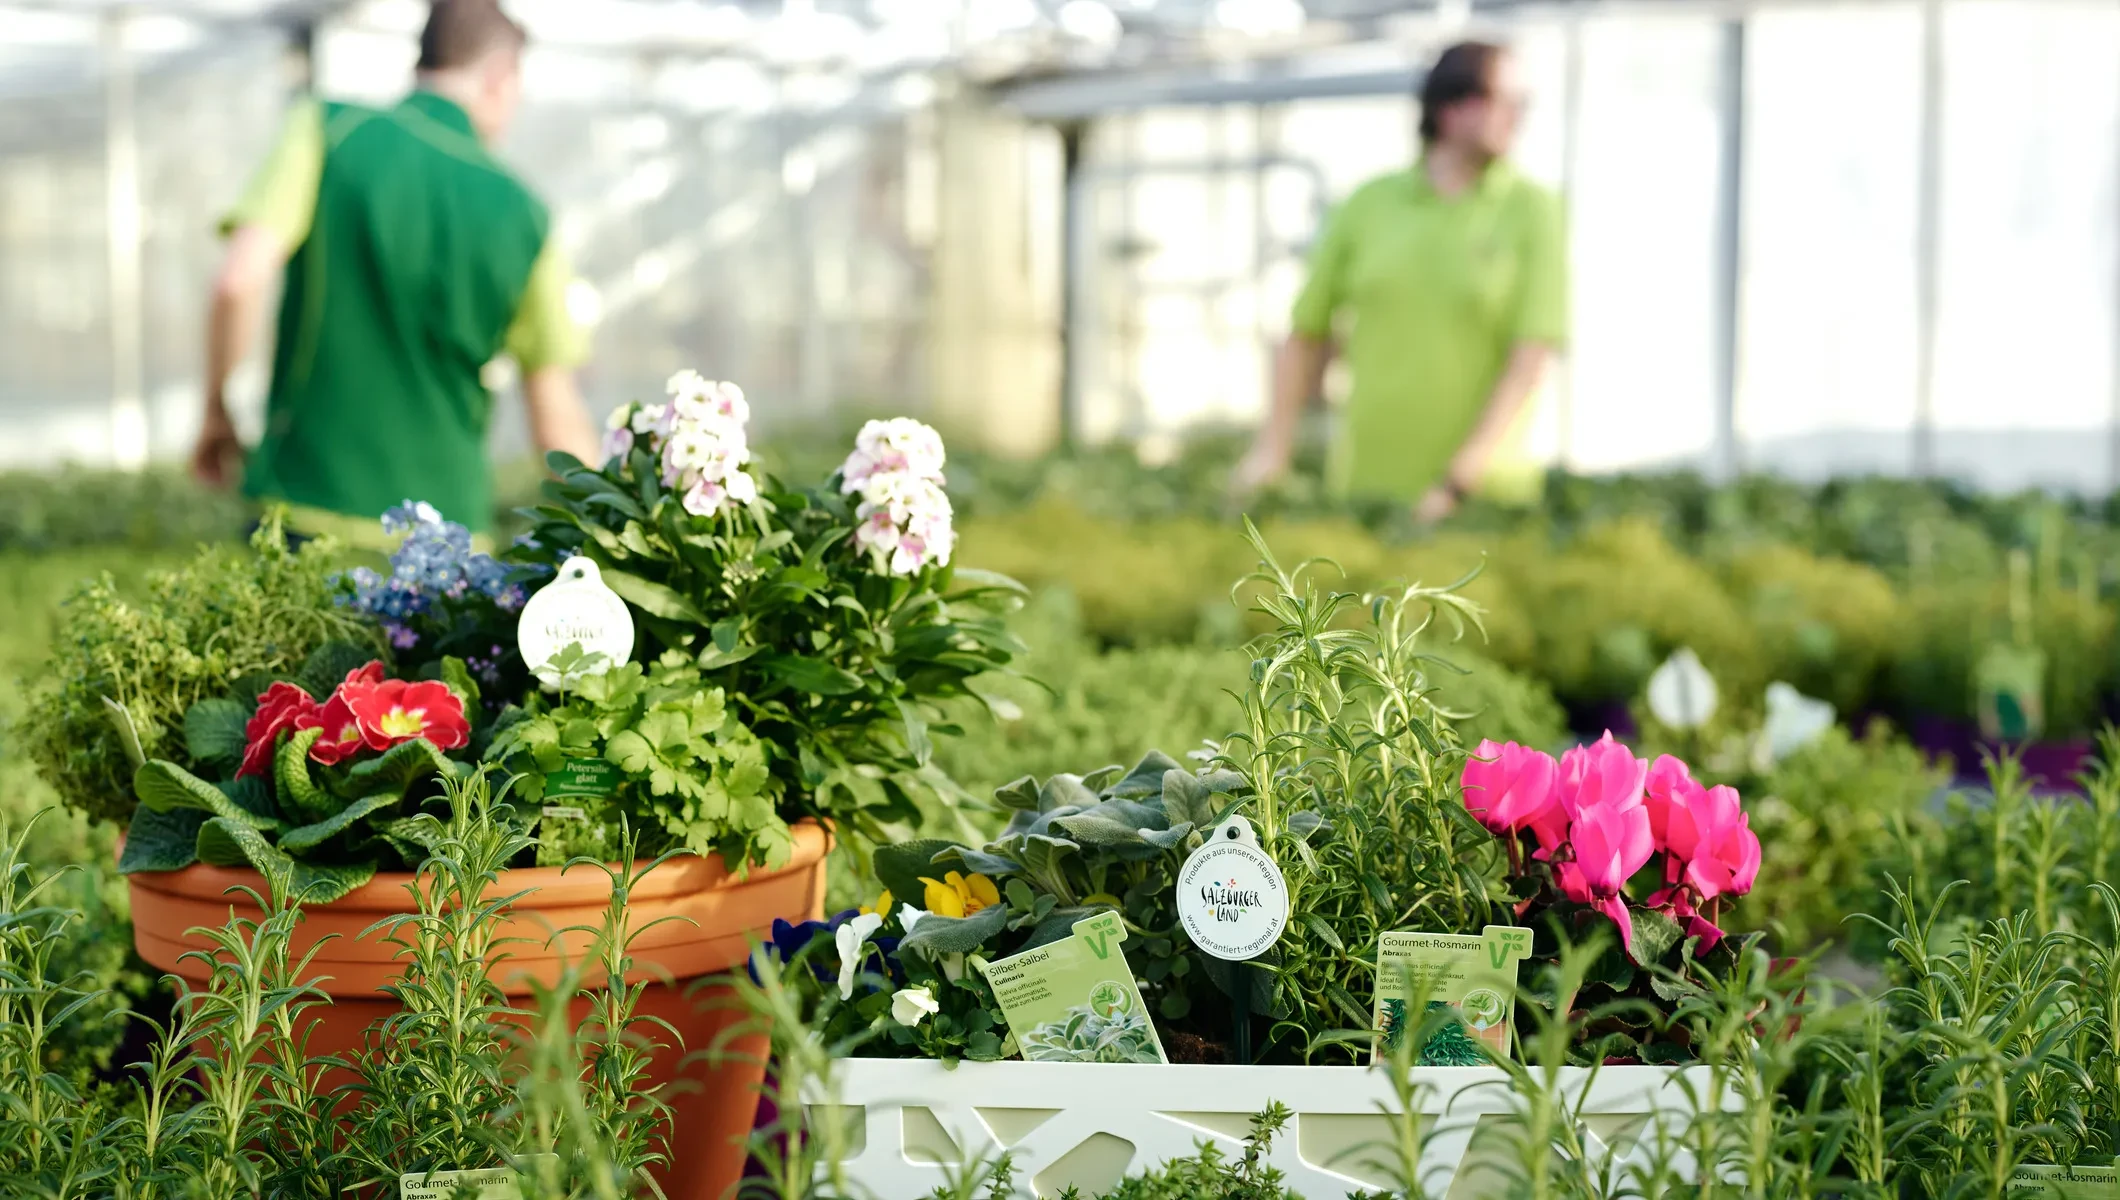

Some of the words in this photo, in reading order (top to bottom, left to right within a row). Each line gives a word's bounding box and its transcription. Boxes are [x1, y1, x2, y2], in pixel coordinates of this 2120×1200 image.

[567, 762, 610, 774] Petersilie
[575, 773, 597, 784] glatt
[1185, 852, 1212, 885] Produkte
[1212, 847, 1226, 857] aus
[1227, 847, 1258, 863] unserer
[1257, 860, 1277, 890] Region
[1201, 885, 1263, 908] SALZBURGER
[1216, 904, 1239, 922] LAND
[1187, 914, 1279, 954] www.garantiert-regional.at
[1383, 936, 1481, 951] Gourmet-Rosmarin
[1382, 949, 1412, 957] Abraxas
[989, 950, 1050, 977] Silber-Salbei
[994, 972, 1025, 986] Culinaria
[999, 986, 1018, 997] Salvia
[1018, 978, 1047, 991] officinalis
[1006, 1001, 1019, 1010] ideal
[1031, 991, 1053, 1002] Kochen
[2014, 1183, 2045, 1192] Abraxas
[406, 1192, 437, 1200] Abraxas
